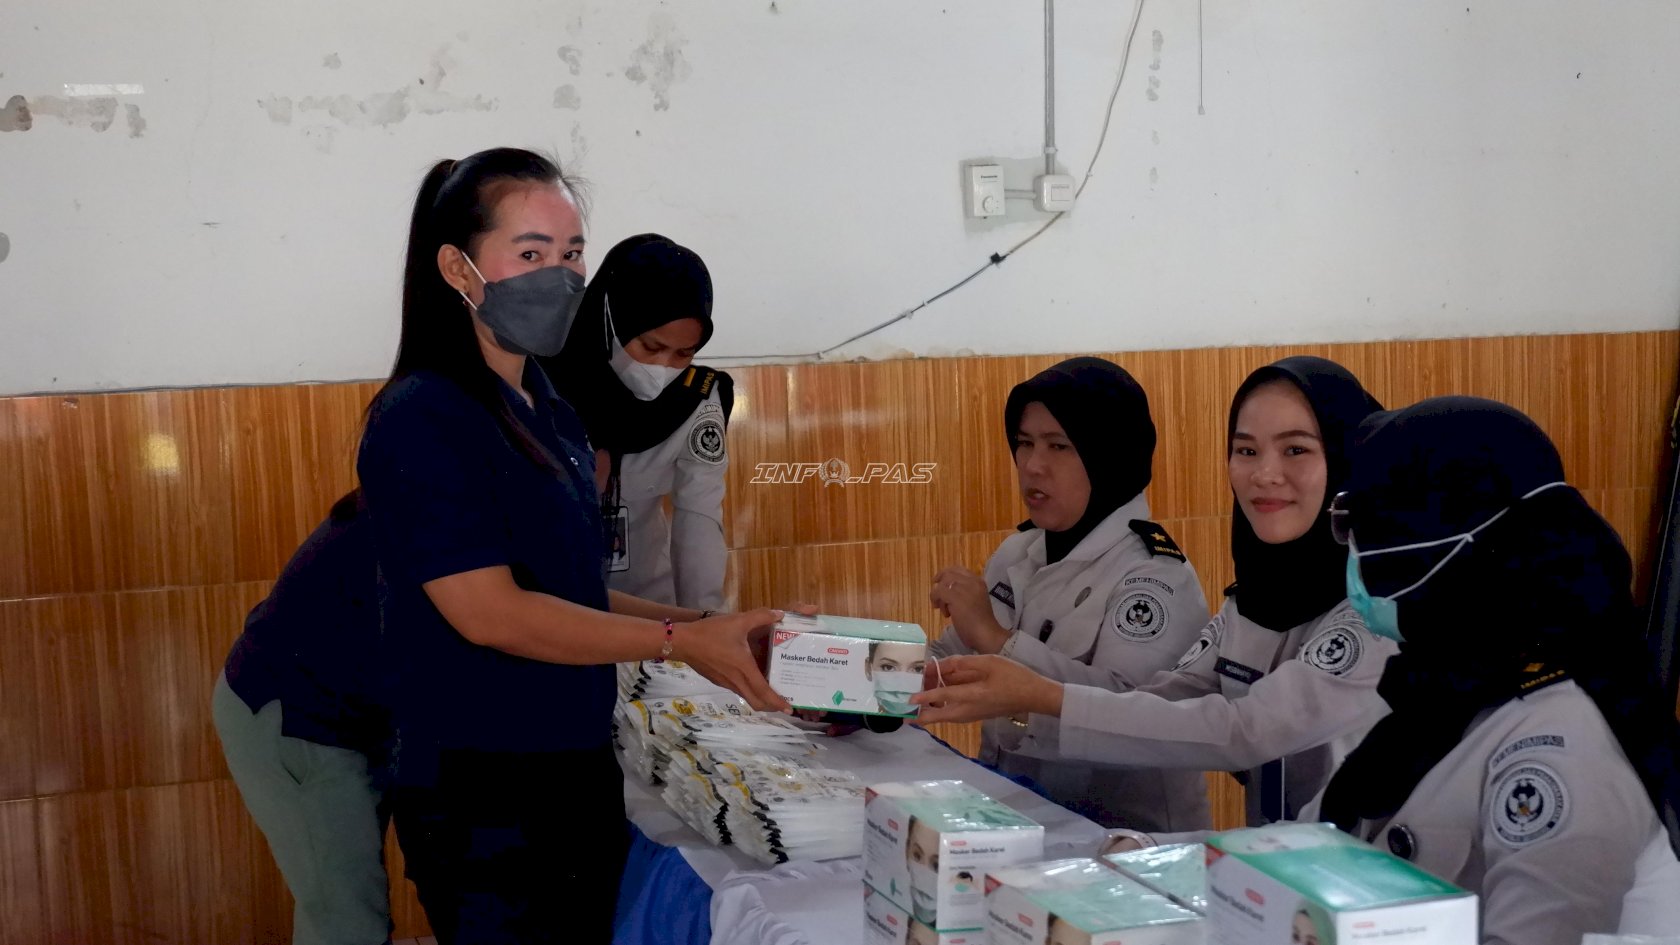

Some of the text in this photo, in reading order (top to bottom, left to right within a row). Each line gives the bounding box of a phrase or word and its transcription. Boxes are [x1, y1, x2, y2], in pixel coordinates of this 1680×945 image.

[780, 653, 849, 666] Masker Bedah Karet
